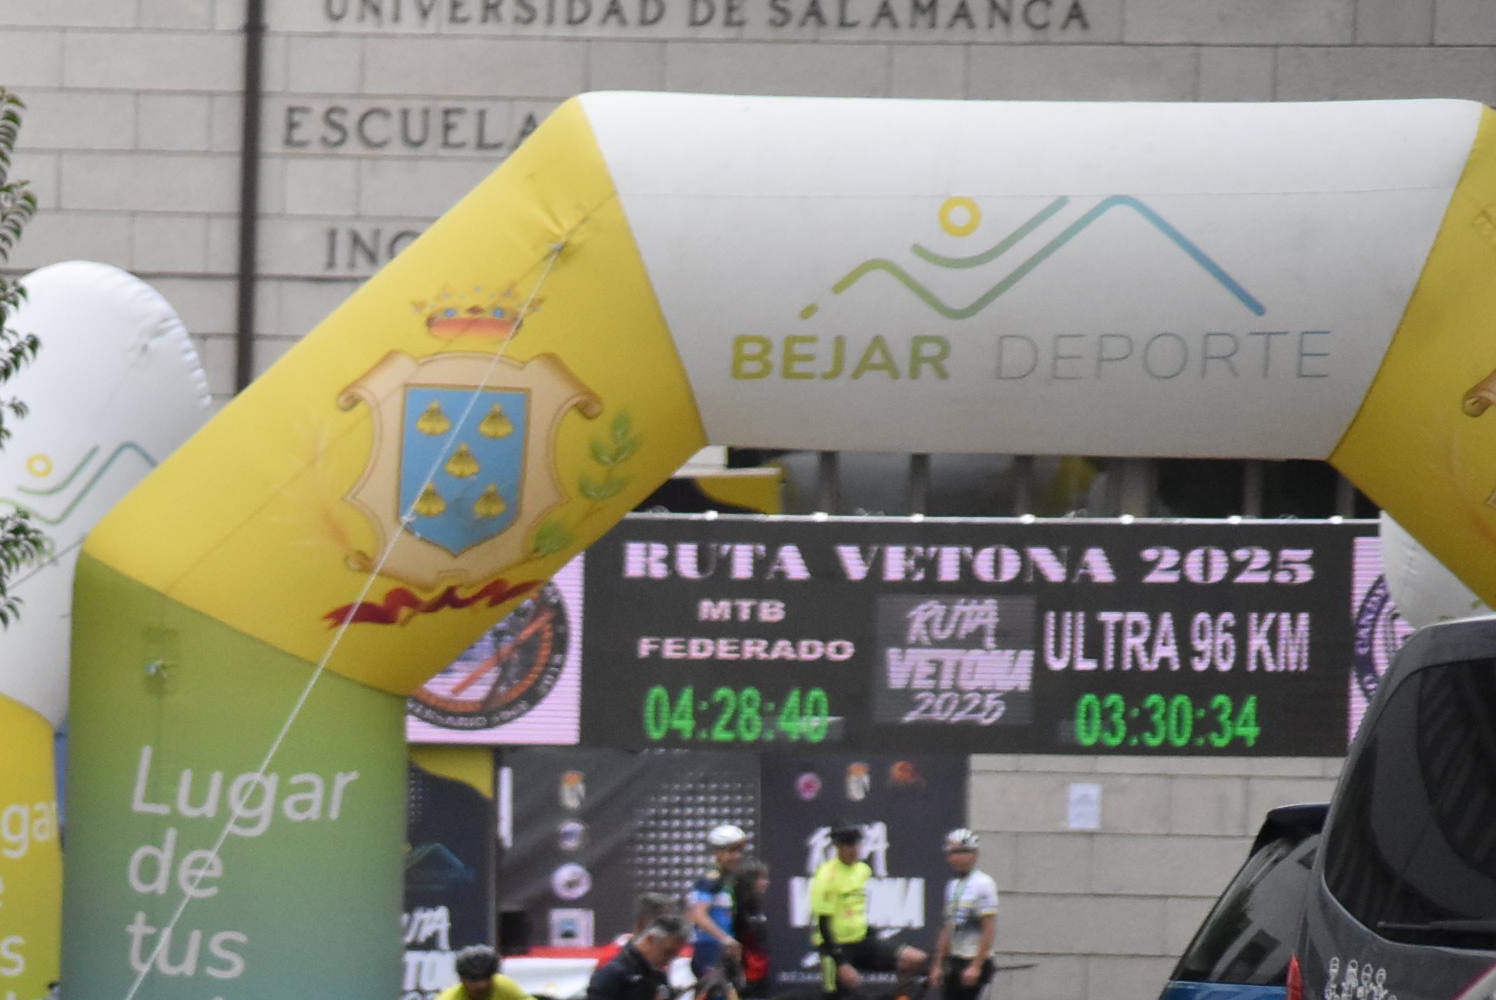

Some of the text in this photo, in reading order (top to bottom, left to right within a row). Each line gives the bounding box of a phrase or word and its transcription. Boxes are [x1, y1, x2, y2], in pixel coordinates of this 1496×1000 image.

[324, 0, 1091, 31] UNIVERSIDAD DE SALAMANCA
[994, 330, 1332, 382] DEPORTE
[622, 542, 1315, 584] RUTA VETONA 2025
[698, 600, 786, 623] MTB
[906, 599, 1000, 650] RUTA
[637, 637, 856, 662] FEDERADO
[1043, 611, 1181, 672] ULTRA
[1190, 612, 1237, 672] 96
[1246, 612, 1311, 672] KM
[887, 648, 1035, 692] VETONA
[644, 684, 830, 743] 04:28:40
[901, 692, 1006, 726] 2025
[1075, 693, 1261, 748] 03:30:34
[131, 746, 360, 837] Lugar
[128, 828, 224, 898] de
[125, 911, 249, 979] tus
